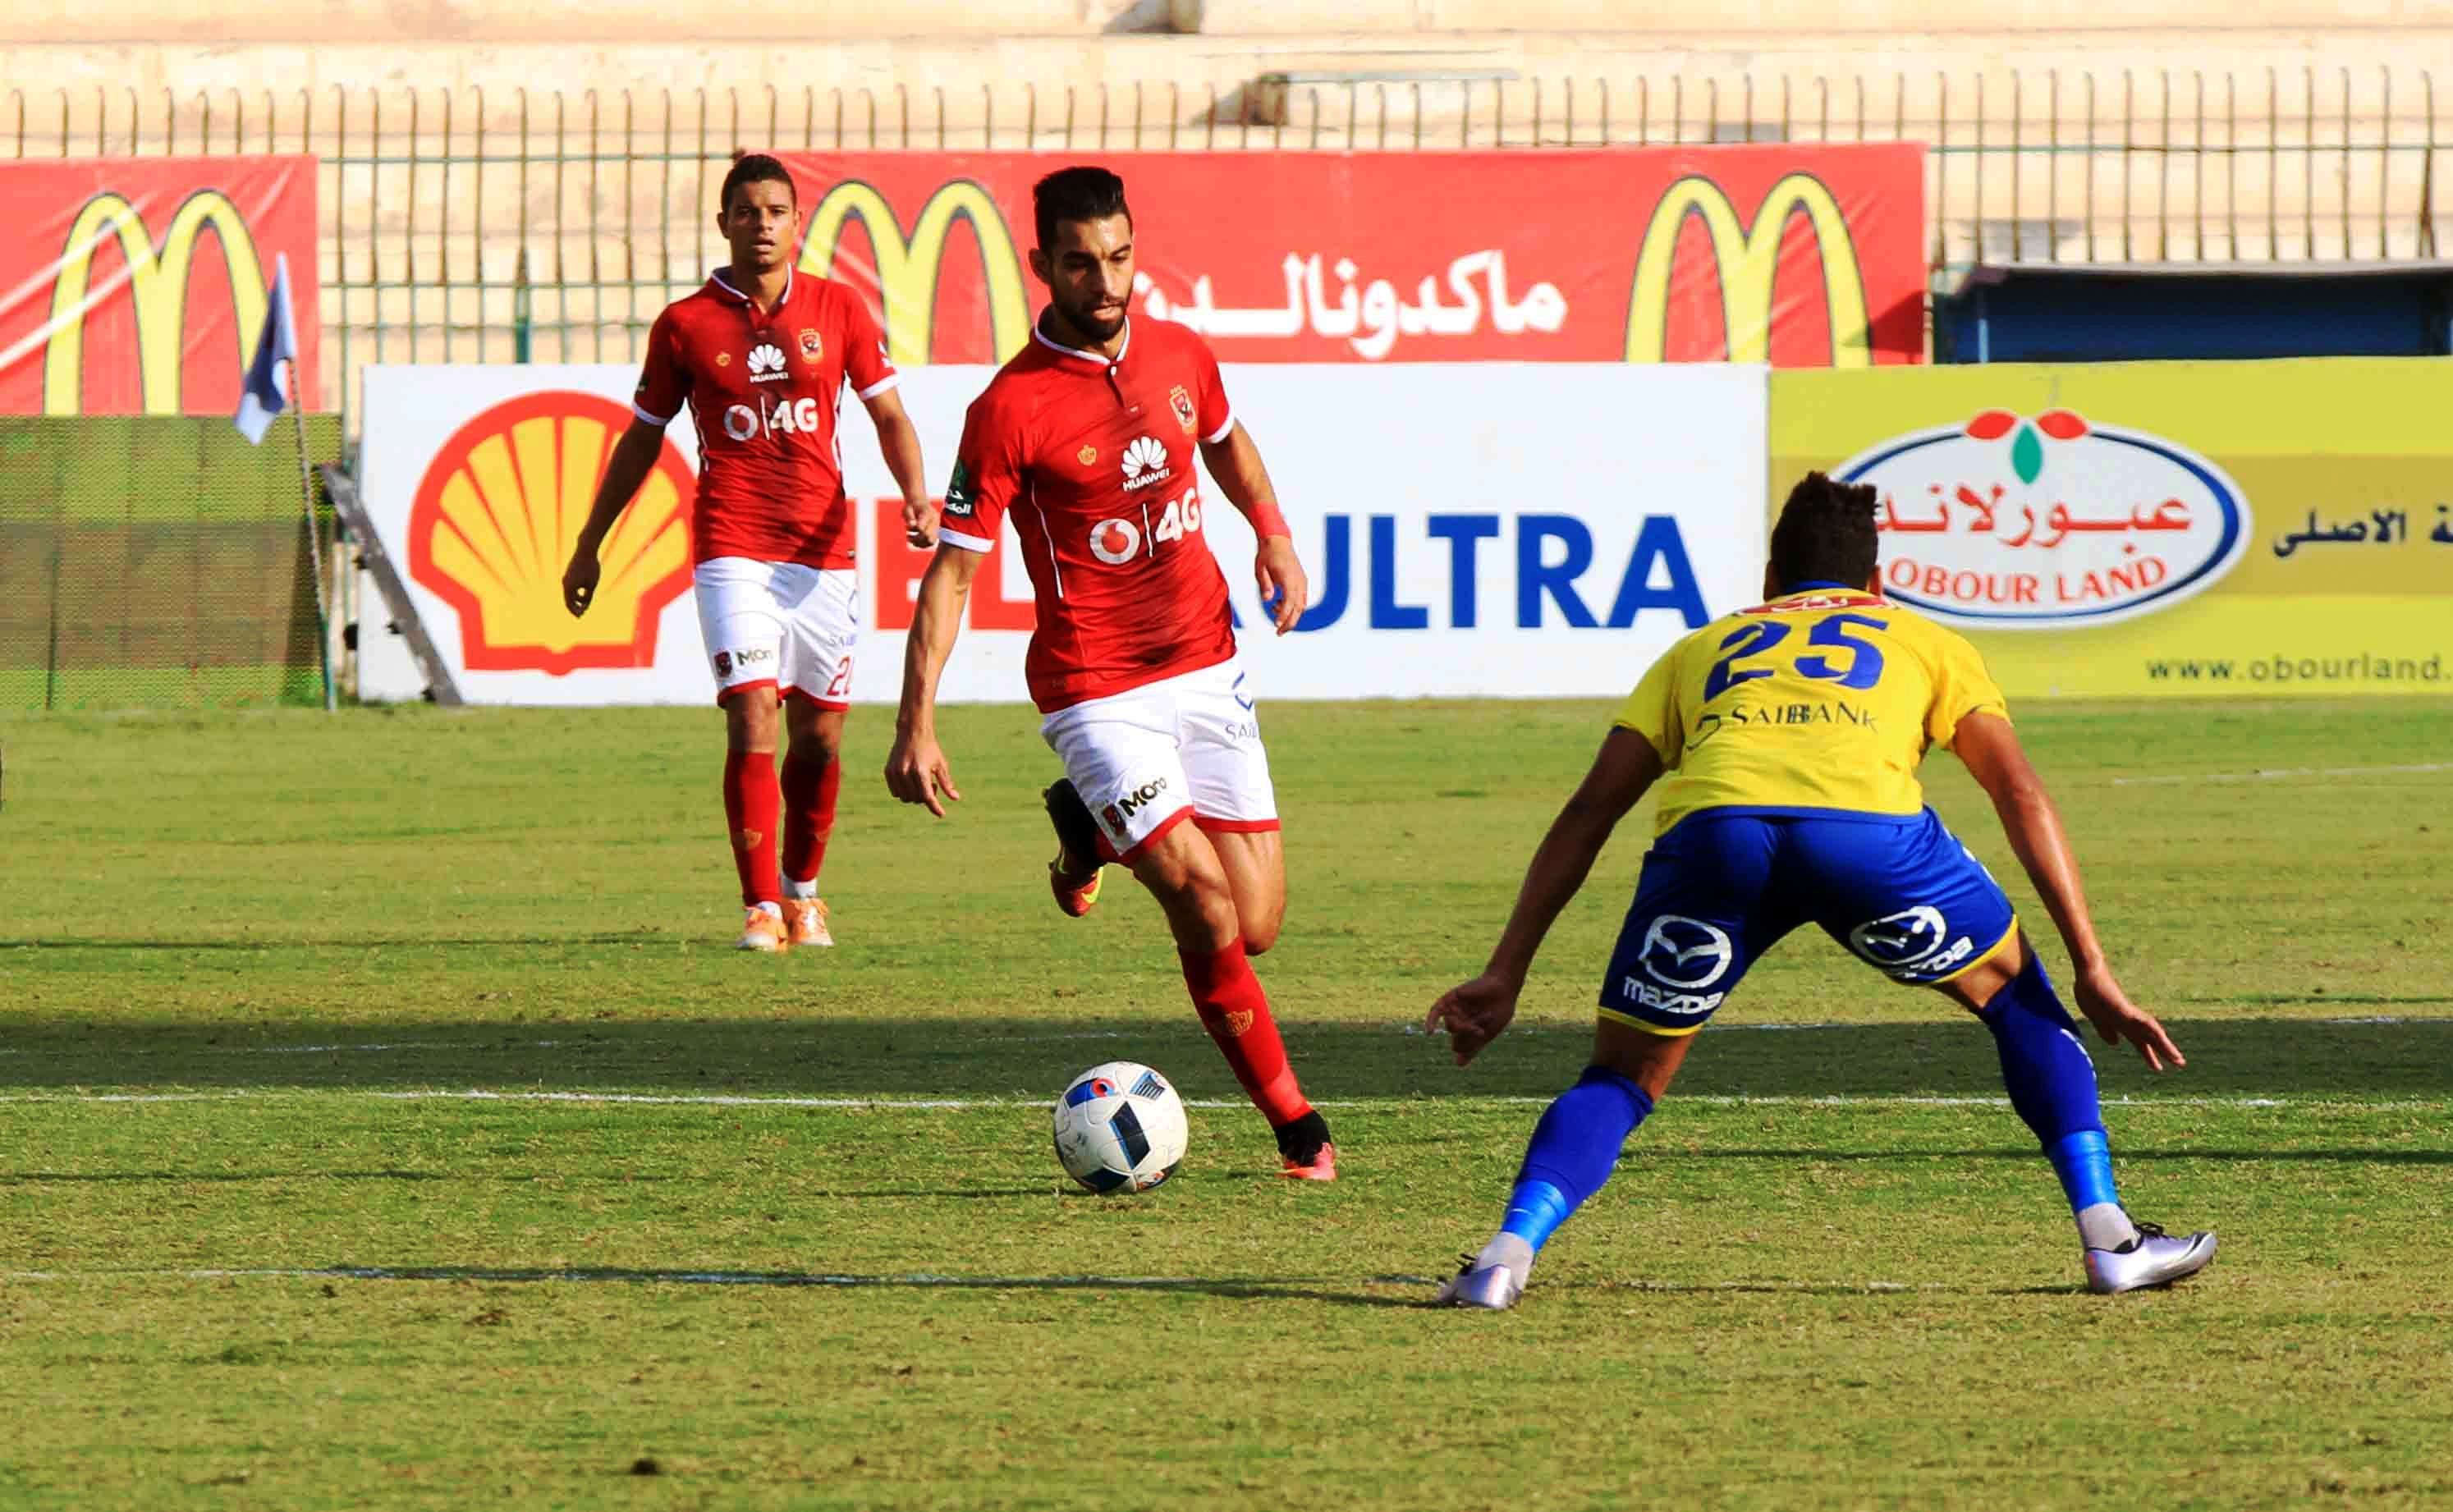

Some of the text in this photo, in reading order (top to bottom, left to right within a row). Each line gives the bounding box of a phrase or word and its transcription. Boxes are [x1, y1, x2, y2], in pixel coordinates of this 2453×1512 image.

[749, 372, 789, 383] HUAWEI
[770, 397, 818, 433] 4G
[1122, 468, 1170, 492] HUAWEI
[1155, 487, 1202, 543] 4G
[1259, 514, 1712, 632] ULTRA
[1888, 556, 2168, 603] OBOUR LAND
[1703, 614, 1889, 704] 25
